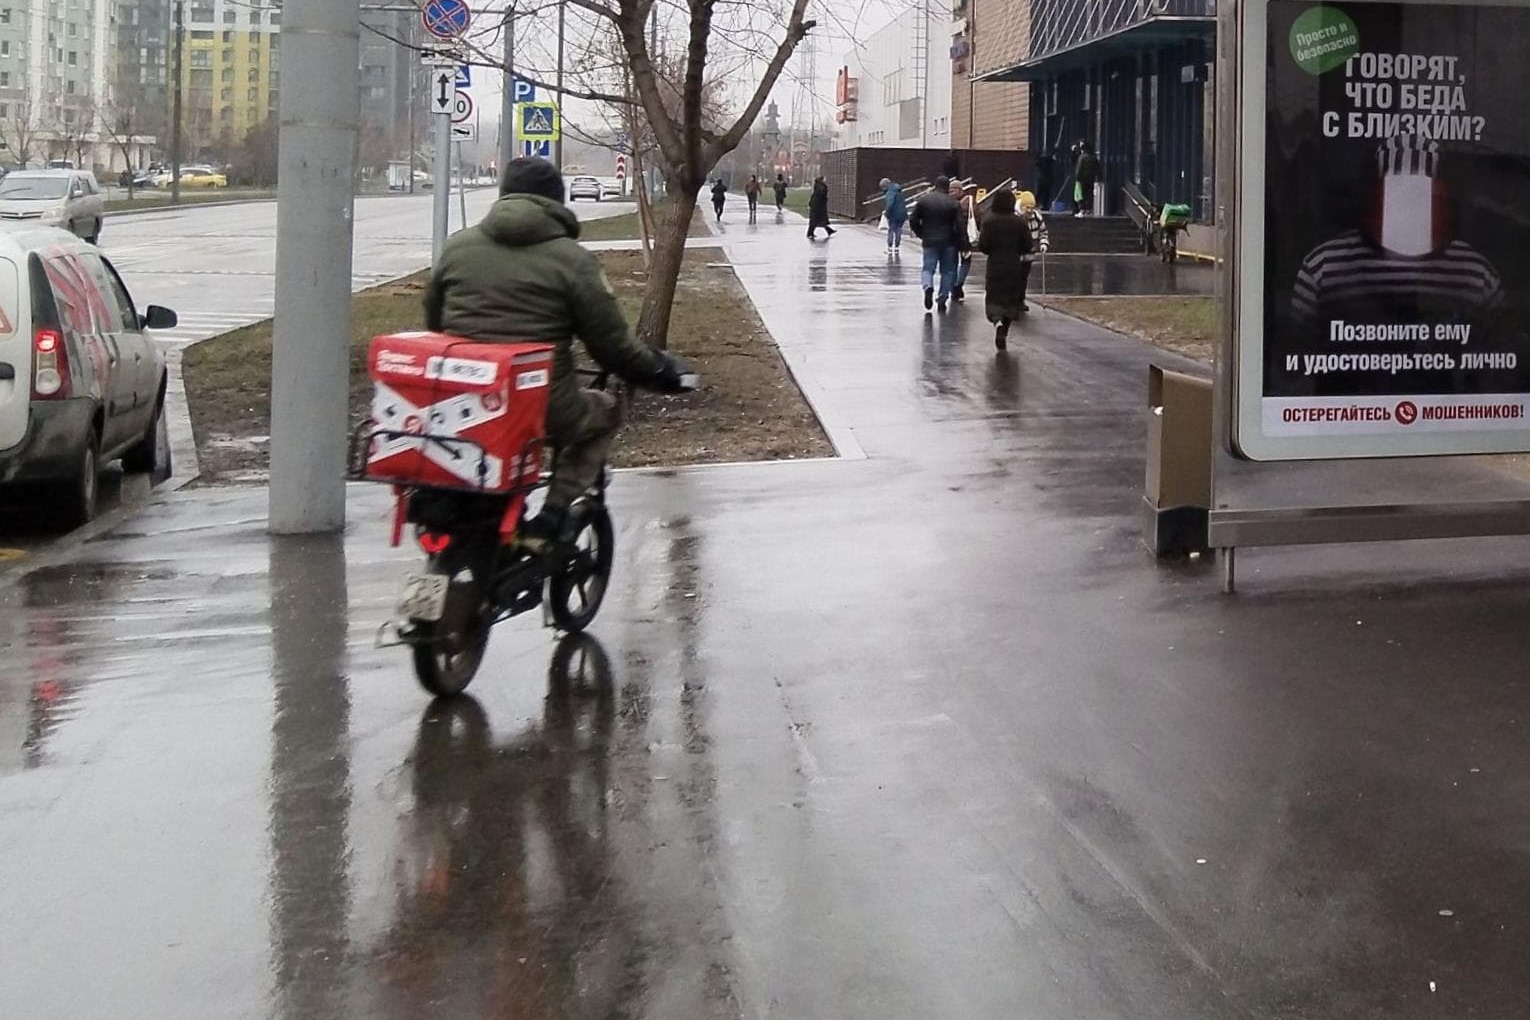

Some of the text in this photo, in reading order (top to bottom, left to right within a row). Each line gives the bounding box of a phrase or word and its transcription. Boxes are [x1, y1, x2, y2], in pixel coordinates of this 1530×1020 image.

[1295, 25, 1338, 47] Просто
[1345, 52, 1466, 85] ГОВОРЯТ,
[1345, 82, 1466, 115] ЧТО БЕДА
[1322, 111, 1486, 141] С БЛИЗКИМ?
[1330, 320, 1471, 345] Позвоните ему
[1286, 351, 1517, 376] и удостоверьтесь лично
[1282, 403, 1525, 423] ОСТЕРЕГАЙТЕСЬ МОШЕННИКОВ!
